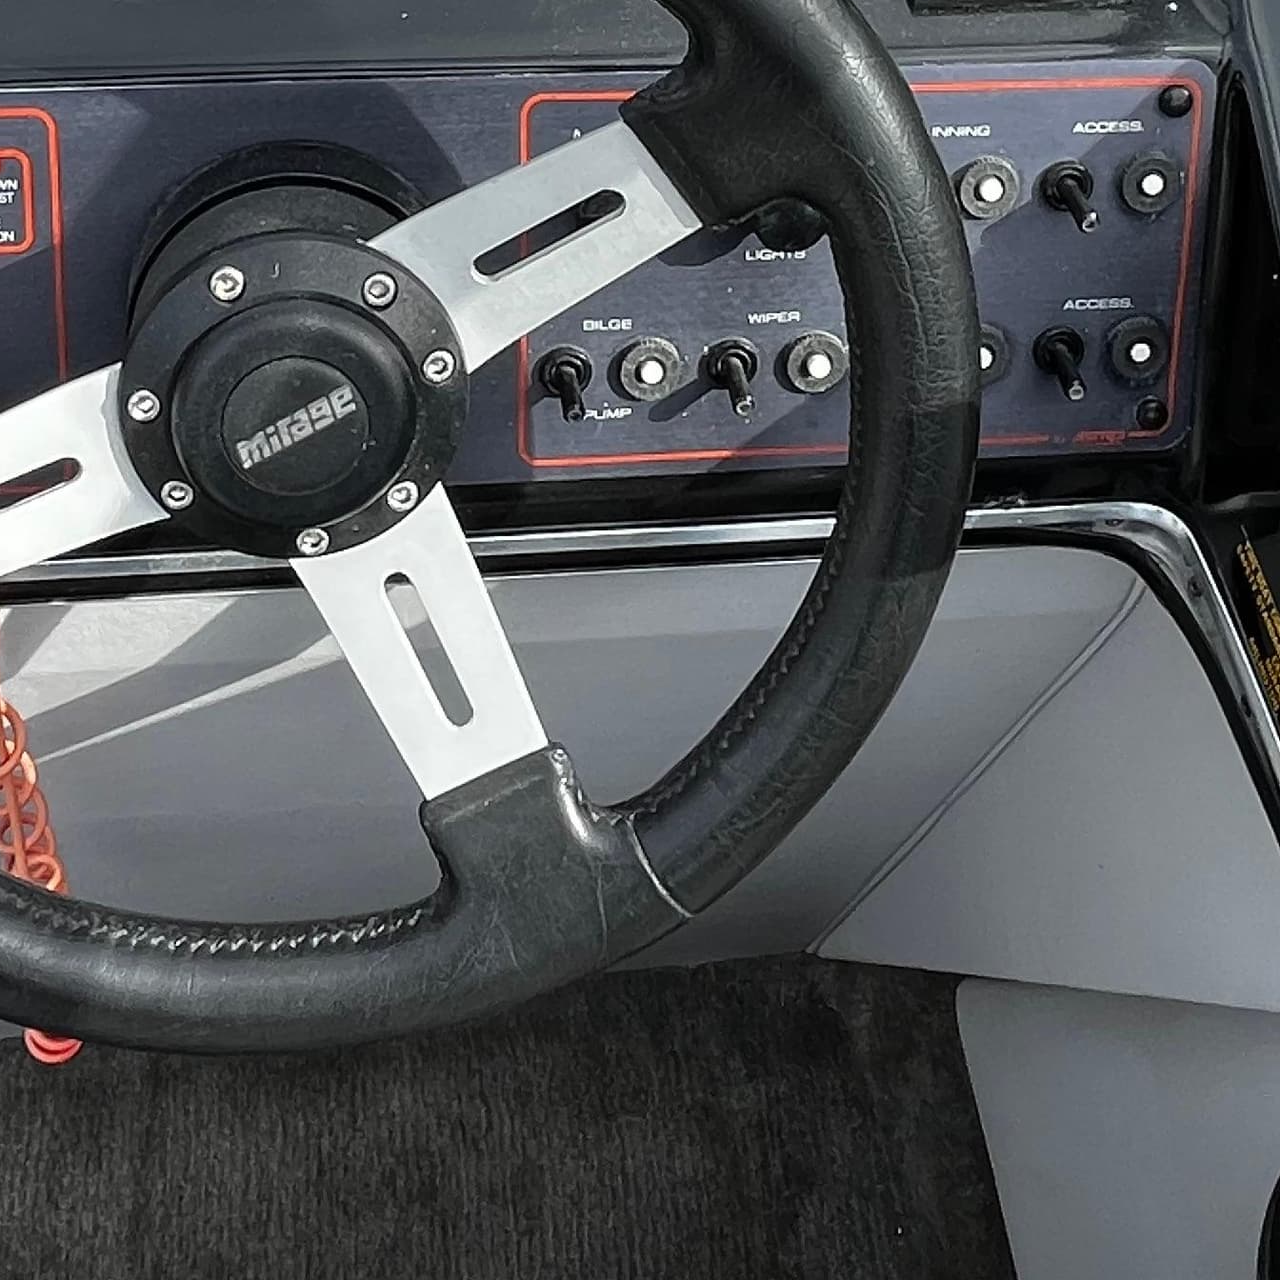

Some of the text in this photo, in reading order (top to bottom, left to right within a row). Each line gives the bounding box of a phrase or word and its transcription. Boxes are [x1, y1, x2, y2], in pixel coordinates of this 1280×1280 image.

[748, 311, 802, 324] WIPER
[582, 318, 632, 331] BILGE
[583, 407, 633, 420] PUMP
